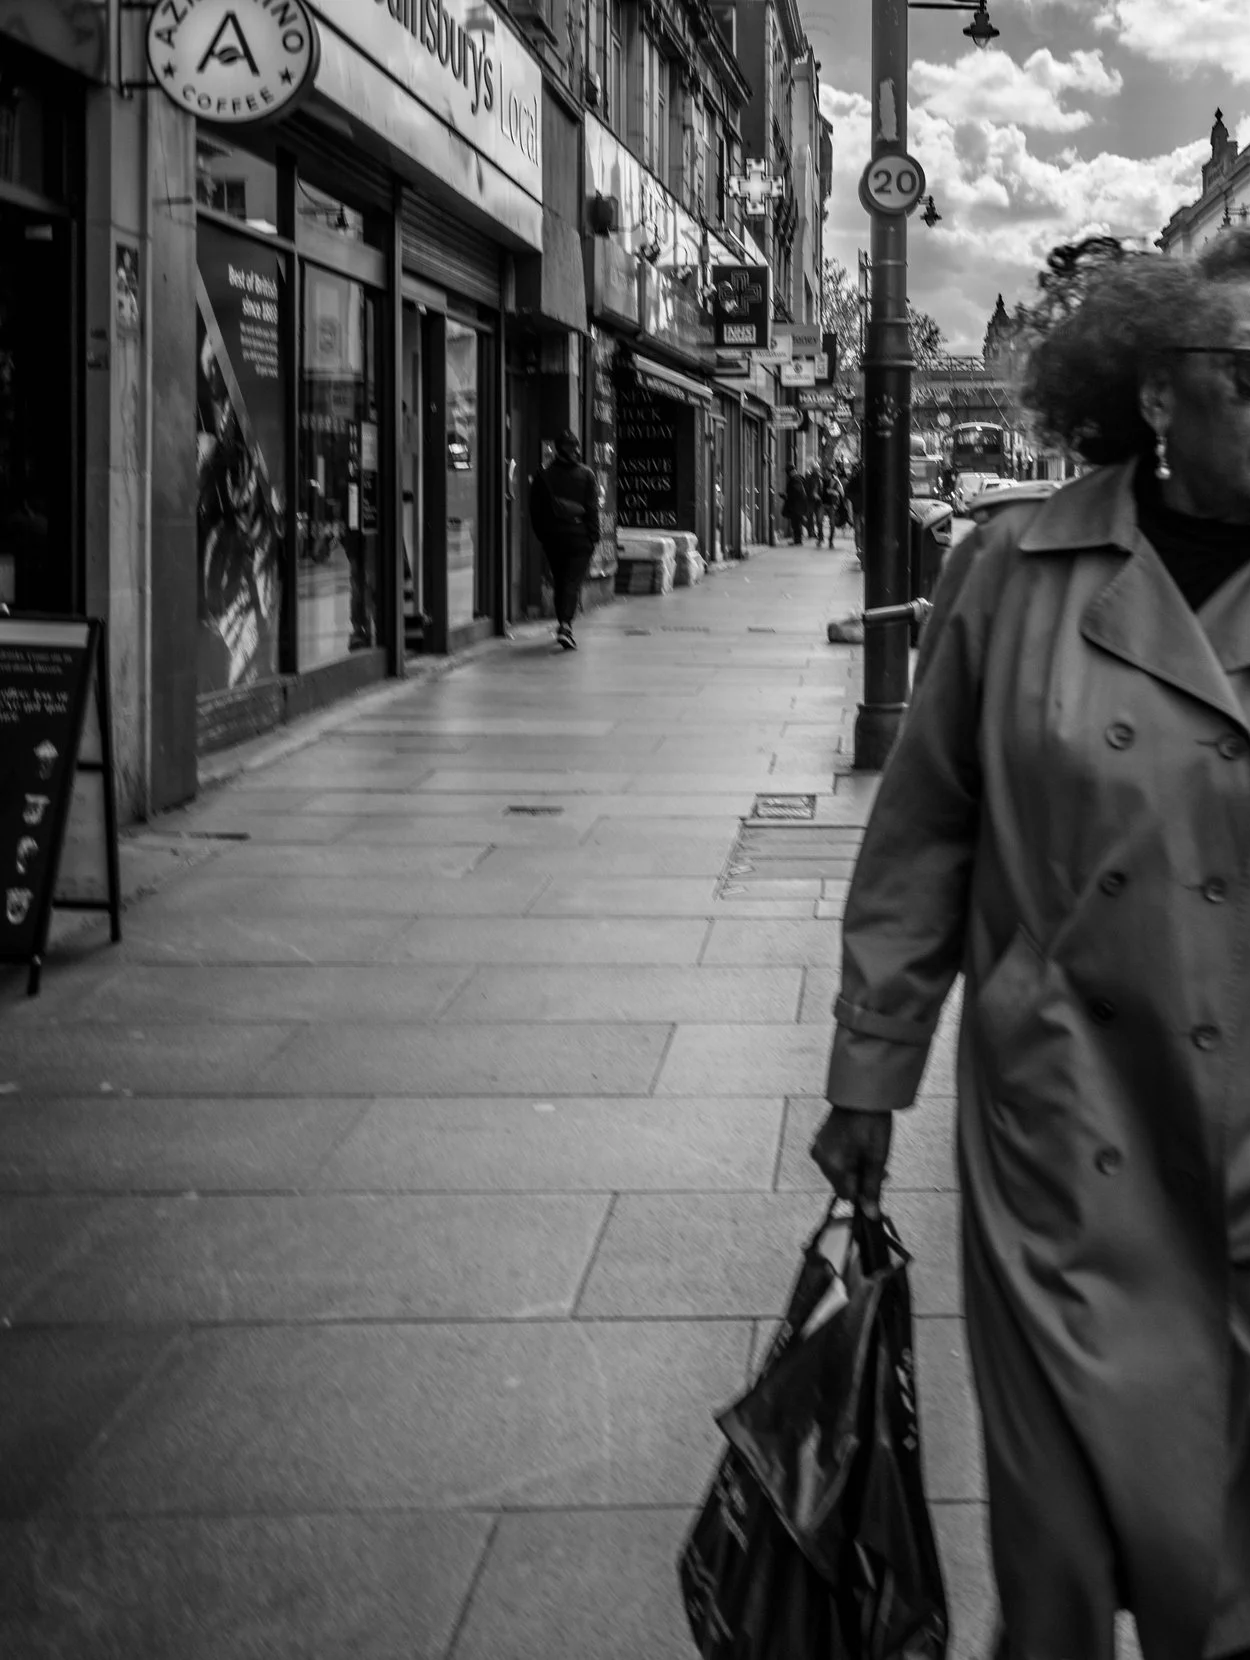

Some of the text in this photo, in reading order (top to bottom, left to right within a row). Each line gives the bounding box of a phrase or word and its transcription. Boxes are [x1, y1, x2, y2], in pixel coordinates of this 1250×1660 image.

[374, 0, 539, 167] nsbury's Local
[182, 84, 273, 116] COFFEE
[873, 170, 917, 195] 20
[728, 325, 755, 342] NHS
[620, 457, 673, 474] ASSIVE
[624, 493, 647, 509] ON
